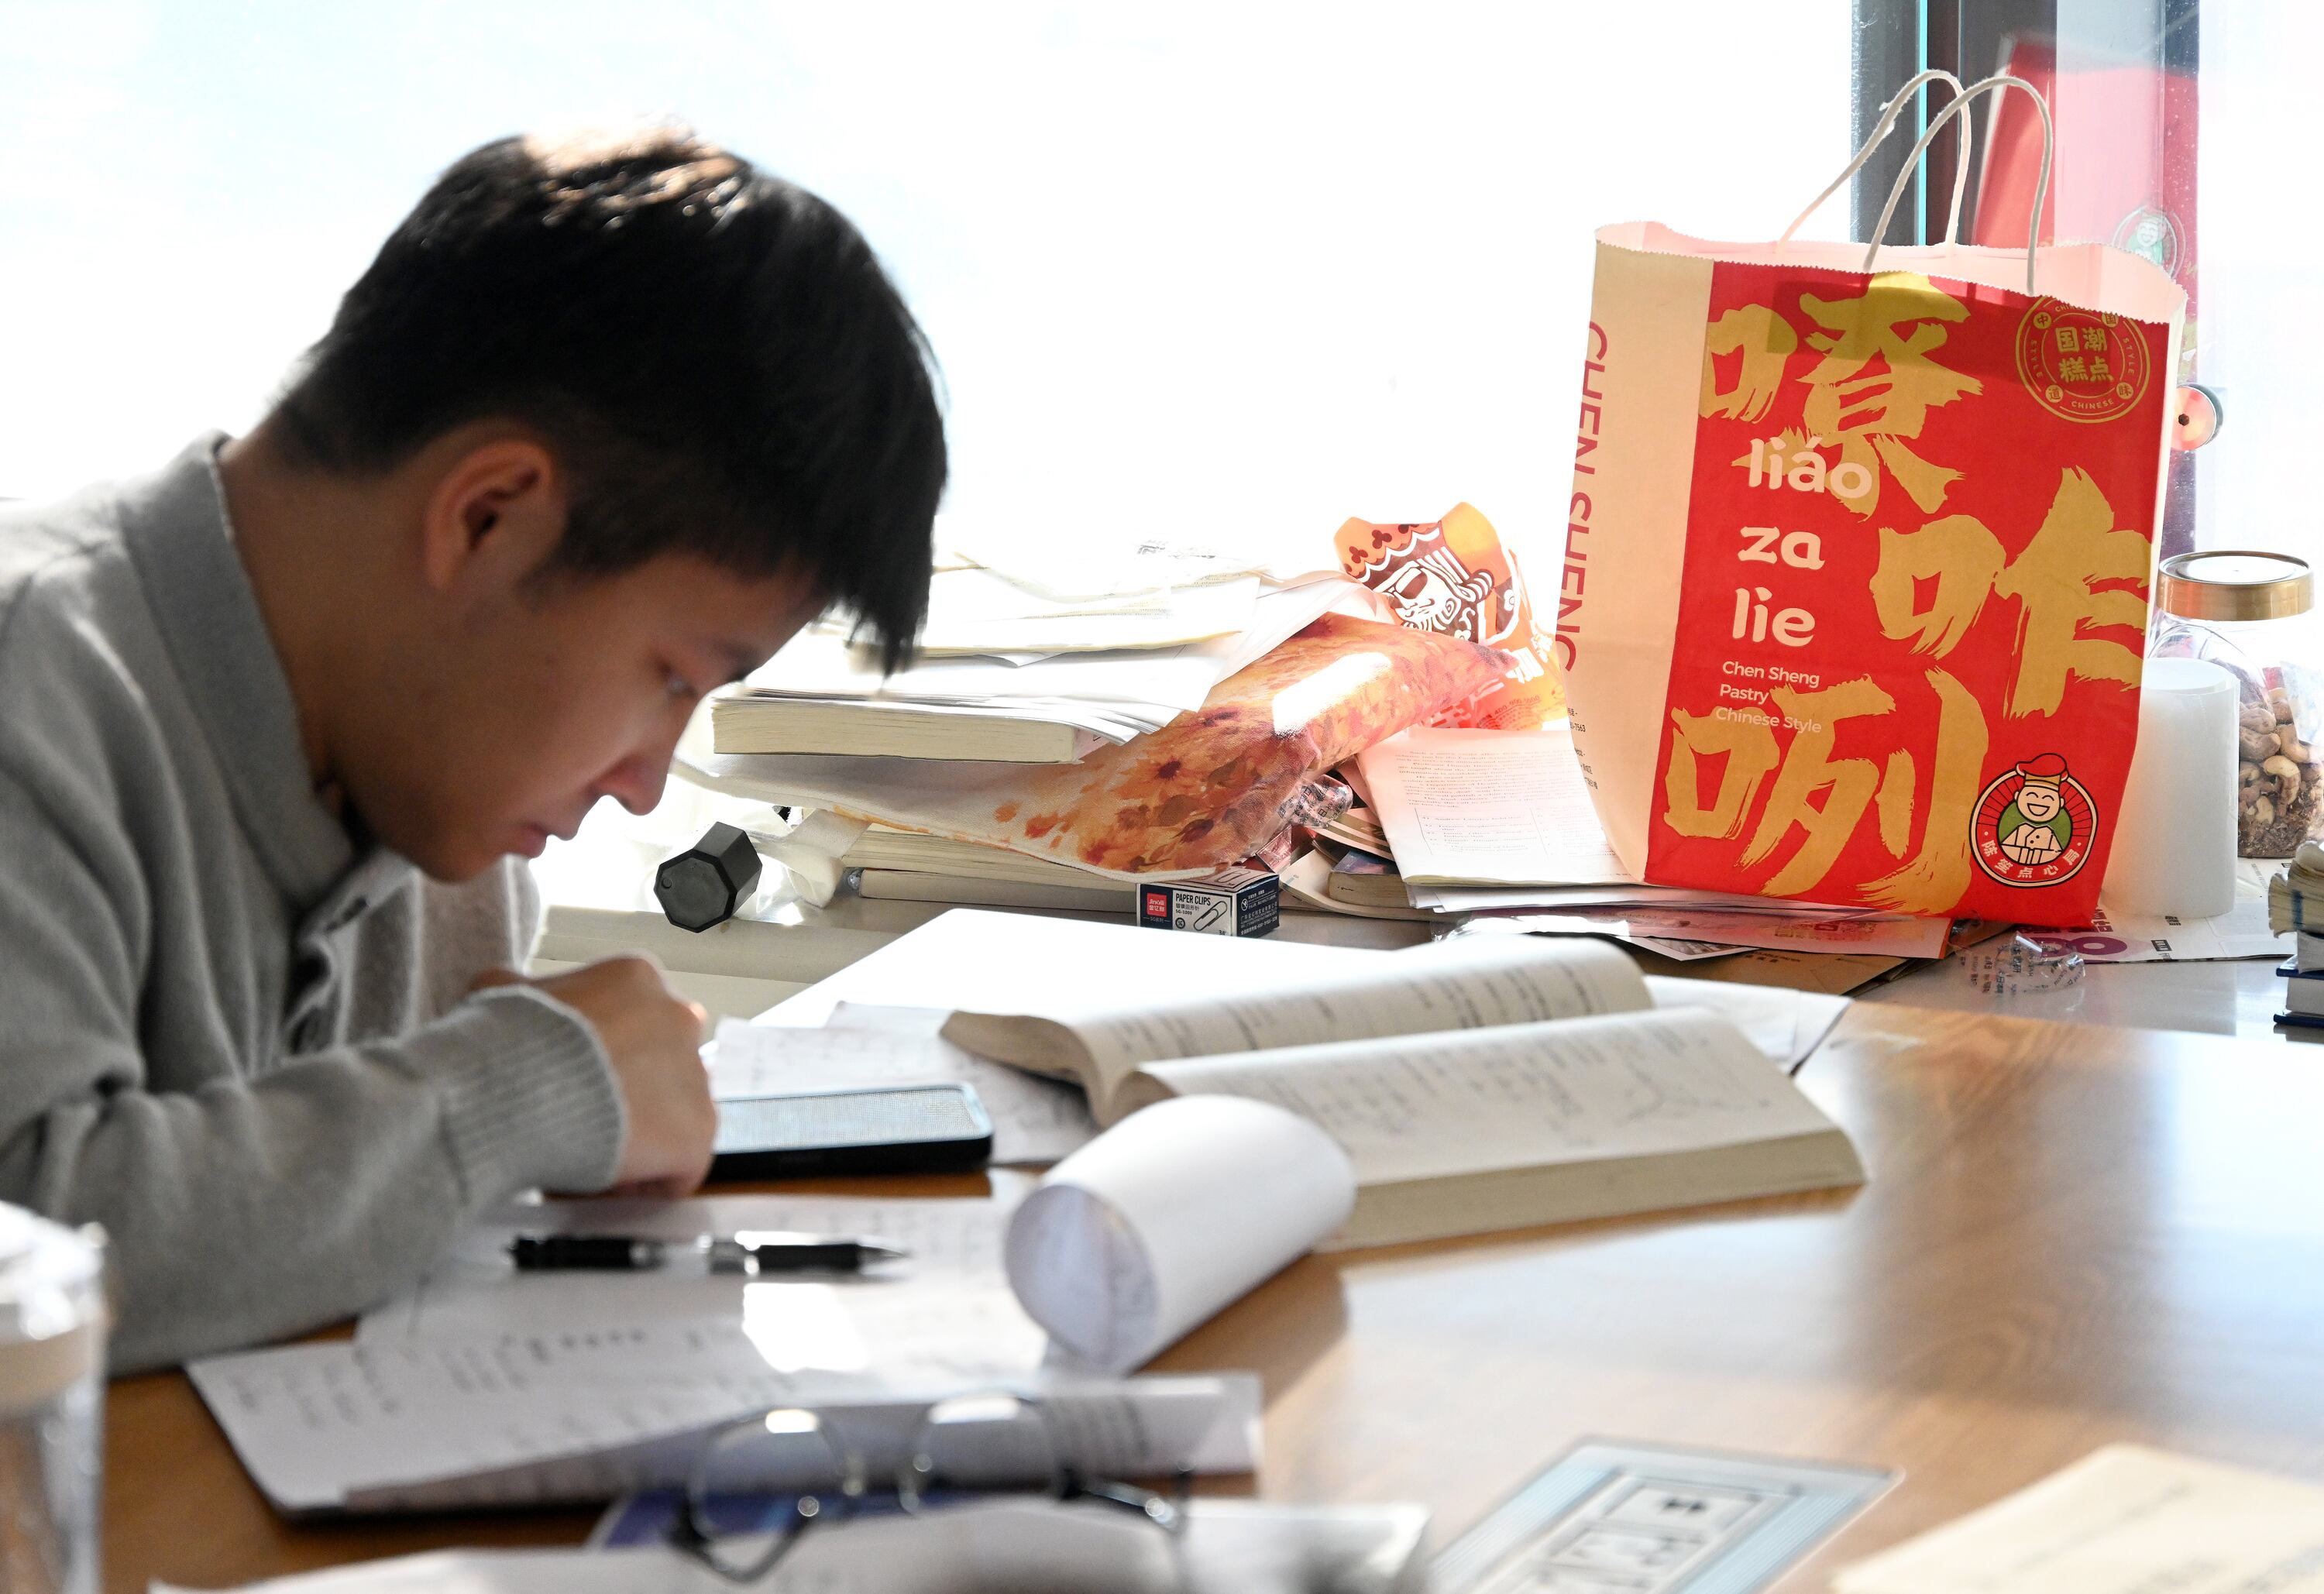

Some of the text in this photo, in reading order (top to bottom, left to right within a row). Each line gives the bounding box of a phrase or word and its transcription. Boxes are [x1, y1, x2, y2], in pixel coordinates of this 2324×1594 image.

[2055, 326, 2108, 353] 国潮
[2030, 339, 2043, 379] STYLE
[2123, 337, 2135, 374] STYLE
[2058, 356, 2114, 383] 糕点
[2071, 399, 2114, 410] CHINESE
[1748, 436, 1872, 499] liáo
[1738, 526, 1825, 570] za
[1722, 661, 1820, 689] Chen Sheng
[1720, 683, 1769, 705] Pastry
[1715, 707, 1821, 733] Chinese Style
[1175, 893, 1211, 906] PAPER CLIPS
